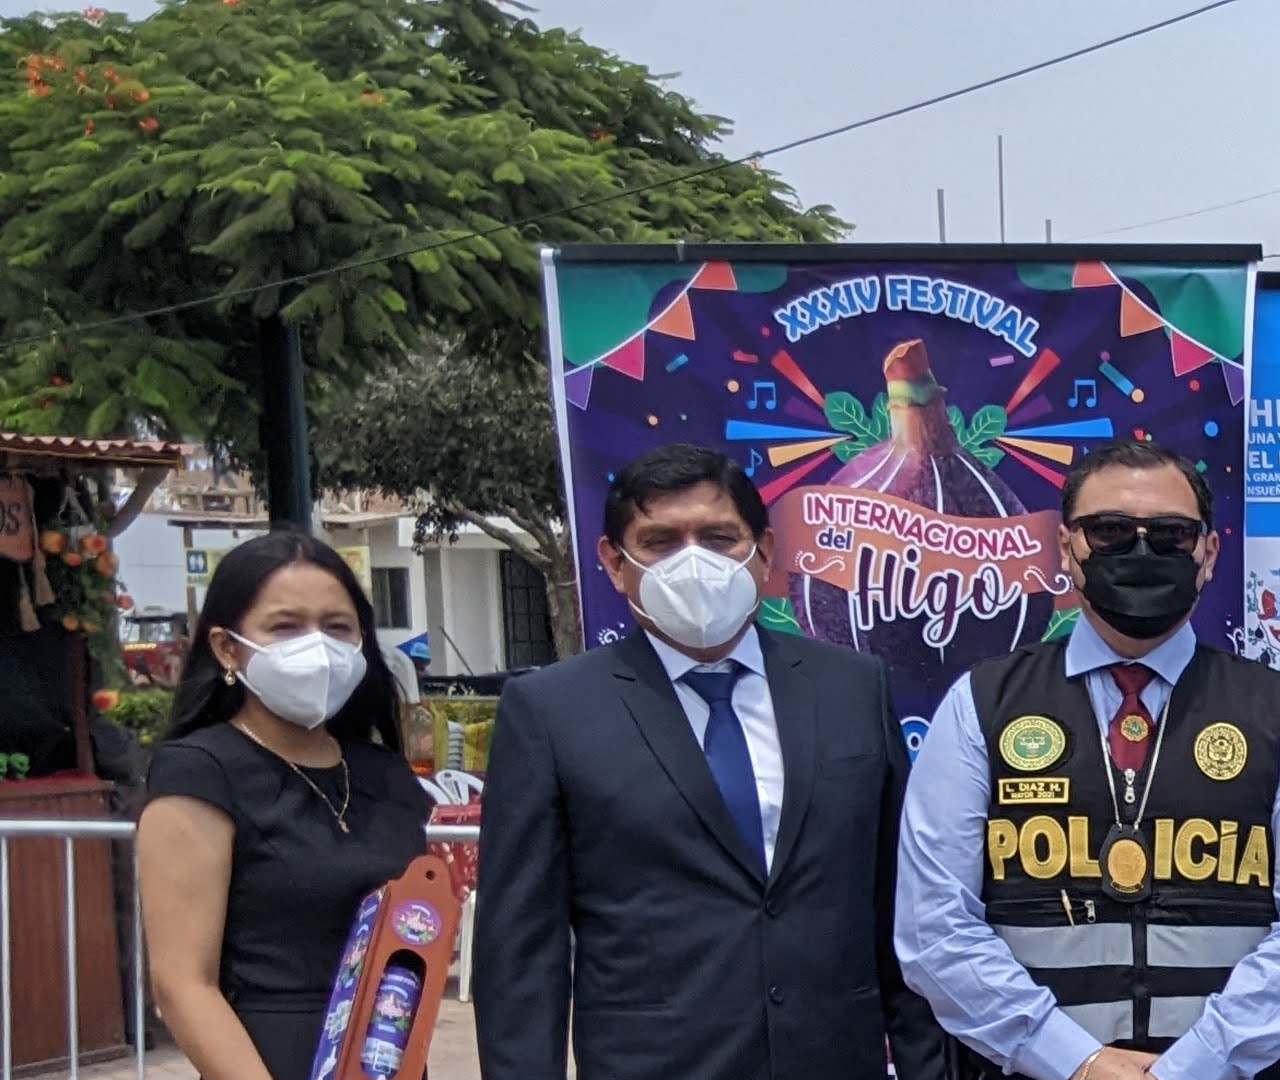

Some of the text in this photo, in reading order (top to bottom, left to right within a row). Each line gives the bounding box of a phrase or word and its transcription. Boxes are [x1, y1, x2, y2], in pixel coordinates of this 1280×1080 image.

[774, 275, 1040, 357] XXXIV FESTIVAL
[1249, 433, 1275, 444] UNA
[1249, 451, 1273, 468] EL
[803, 493, 1042, 560] INTERNACIONAL
[817, 526, 853, 553] del
[854, 544, 1023, 647] Higo
[1019, 783, 1045, 791] DIAZ
